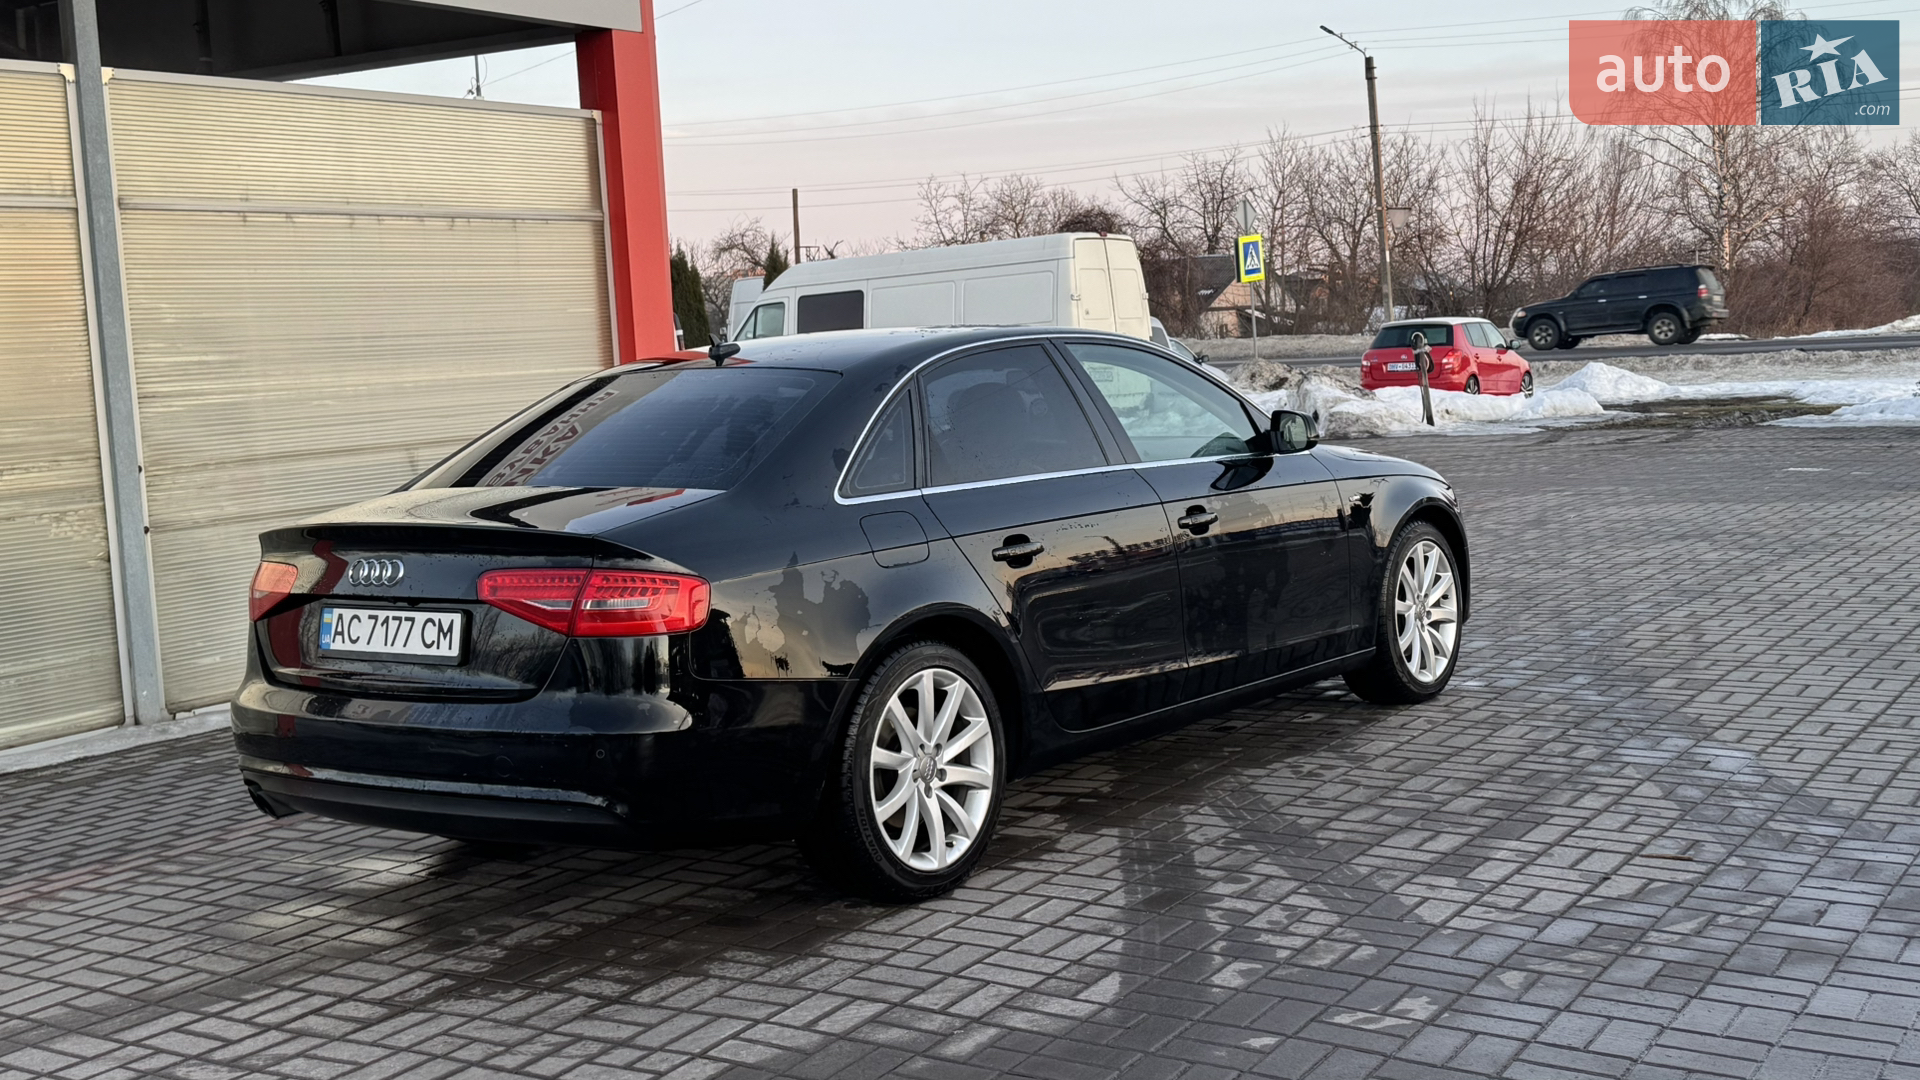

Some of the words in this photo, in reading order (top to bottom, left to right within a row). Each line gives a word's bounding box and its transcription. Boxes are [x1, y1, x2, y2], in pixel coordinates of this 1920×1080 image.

[332, 613, 361, 644] AC
[366, 614, 416, 648] 7177
[421, 617, 454, 651] CM
